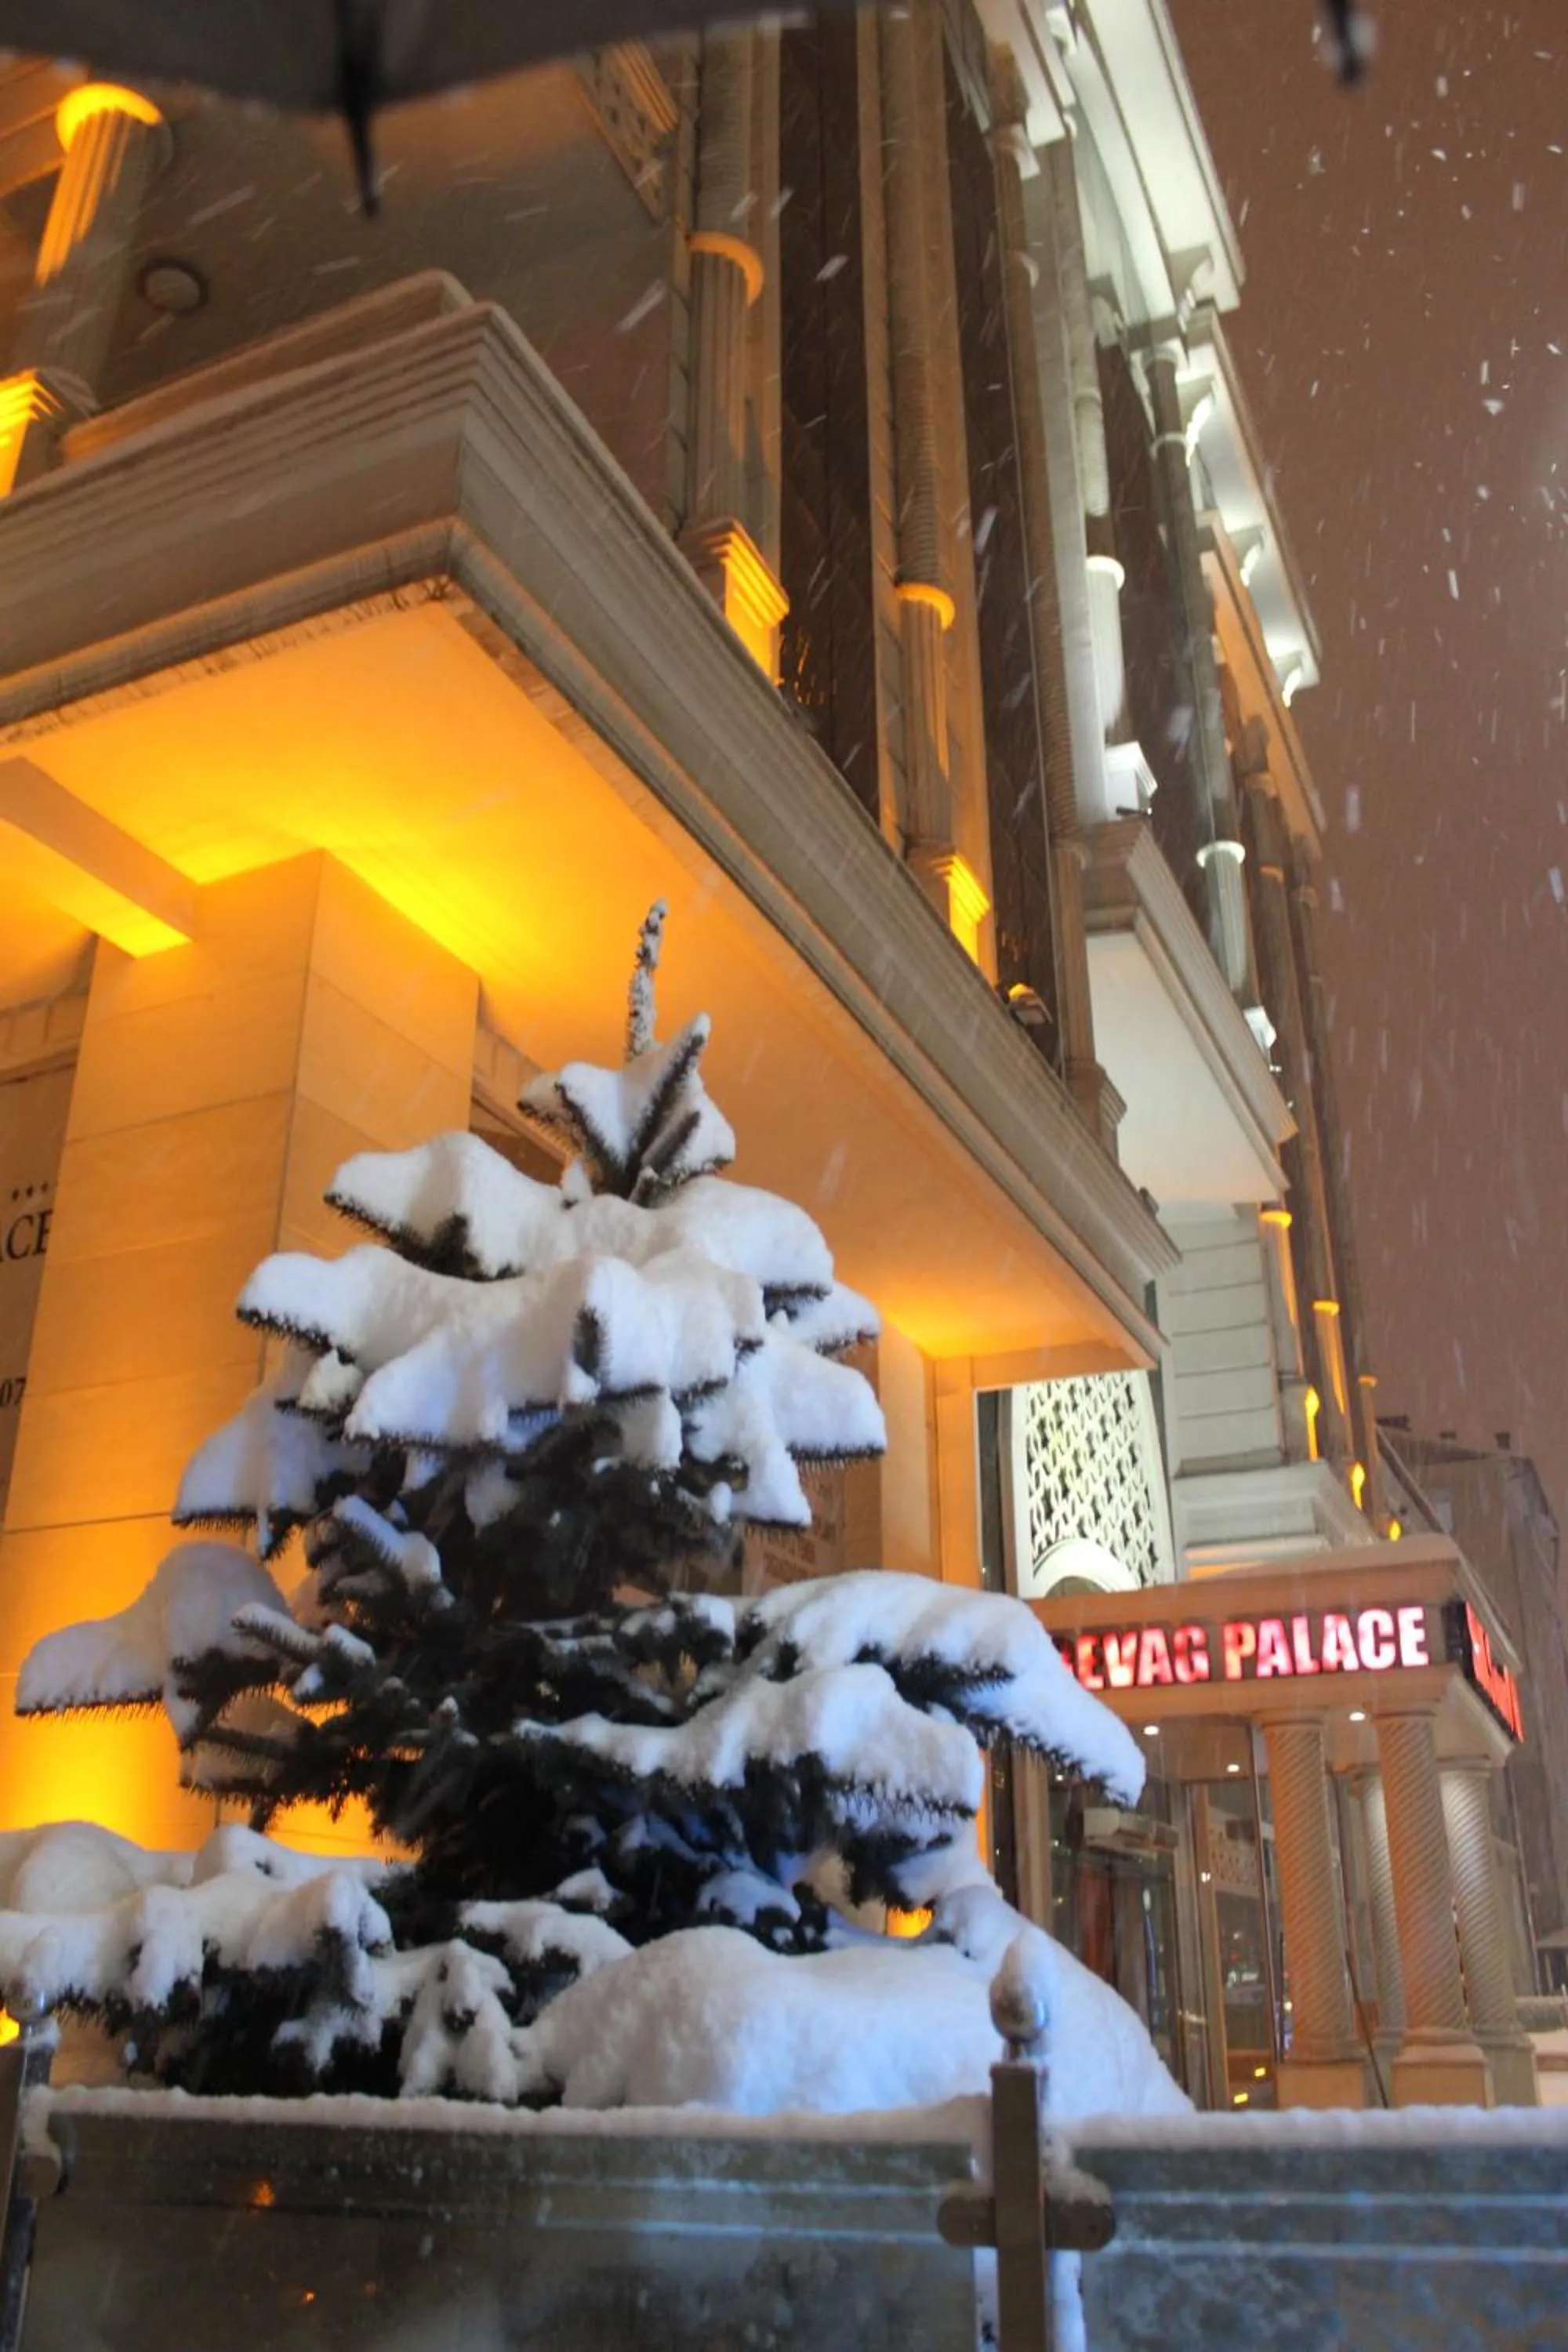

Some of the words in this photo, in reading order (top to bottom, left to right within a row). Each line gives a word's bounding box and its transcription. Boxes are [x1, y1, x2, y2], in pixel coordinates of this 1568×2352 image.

[0, 1208, 53, 1263] CE
[1061, 1624, 1210, 1691] EVAG
[1221, 1605, 1429, 1680] PALACE
